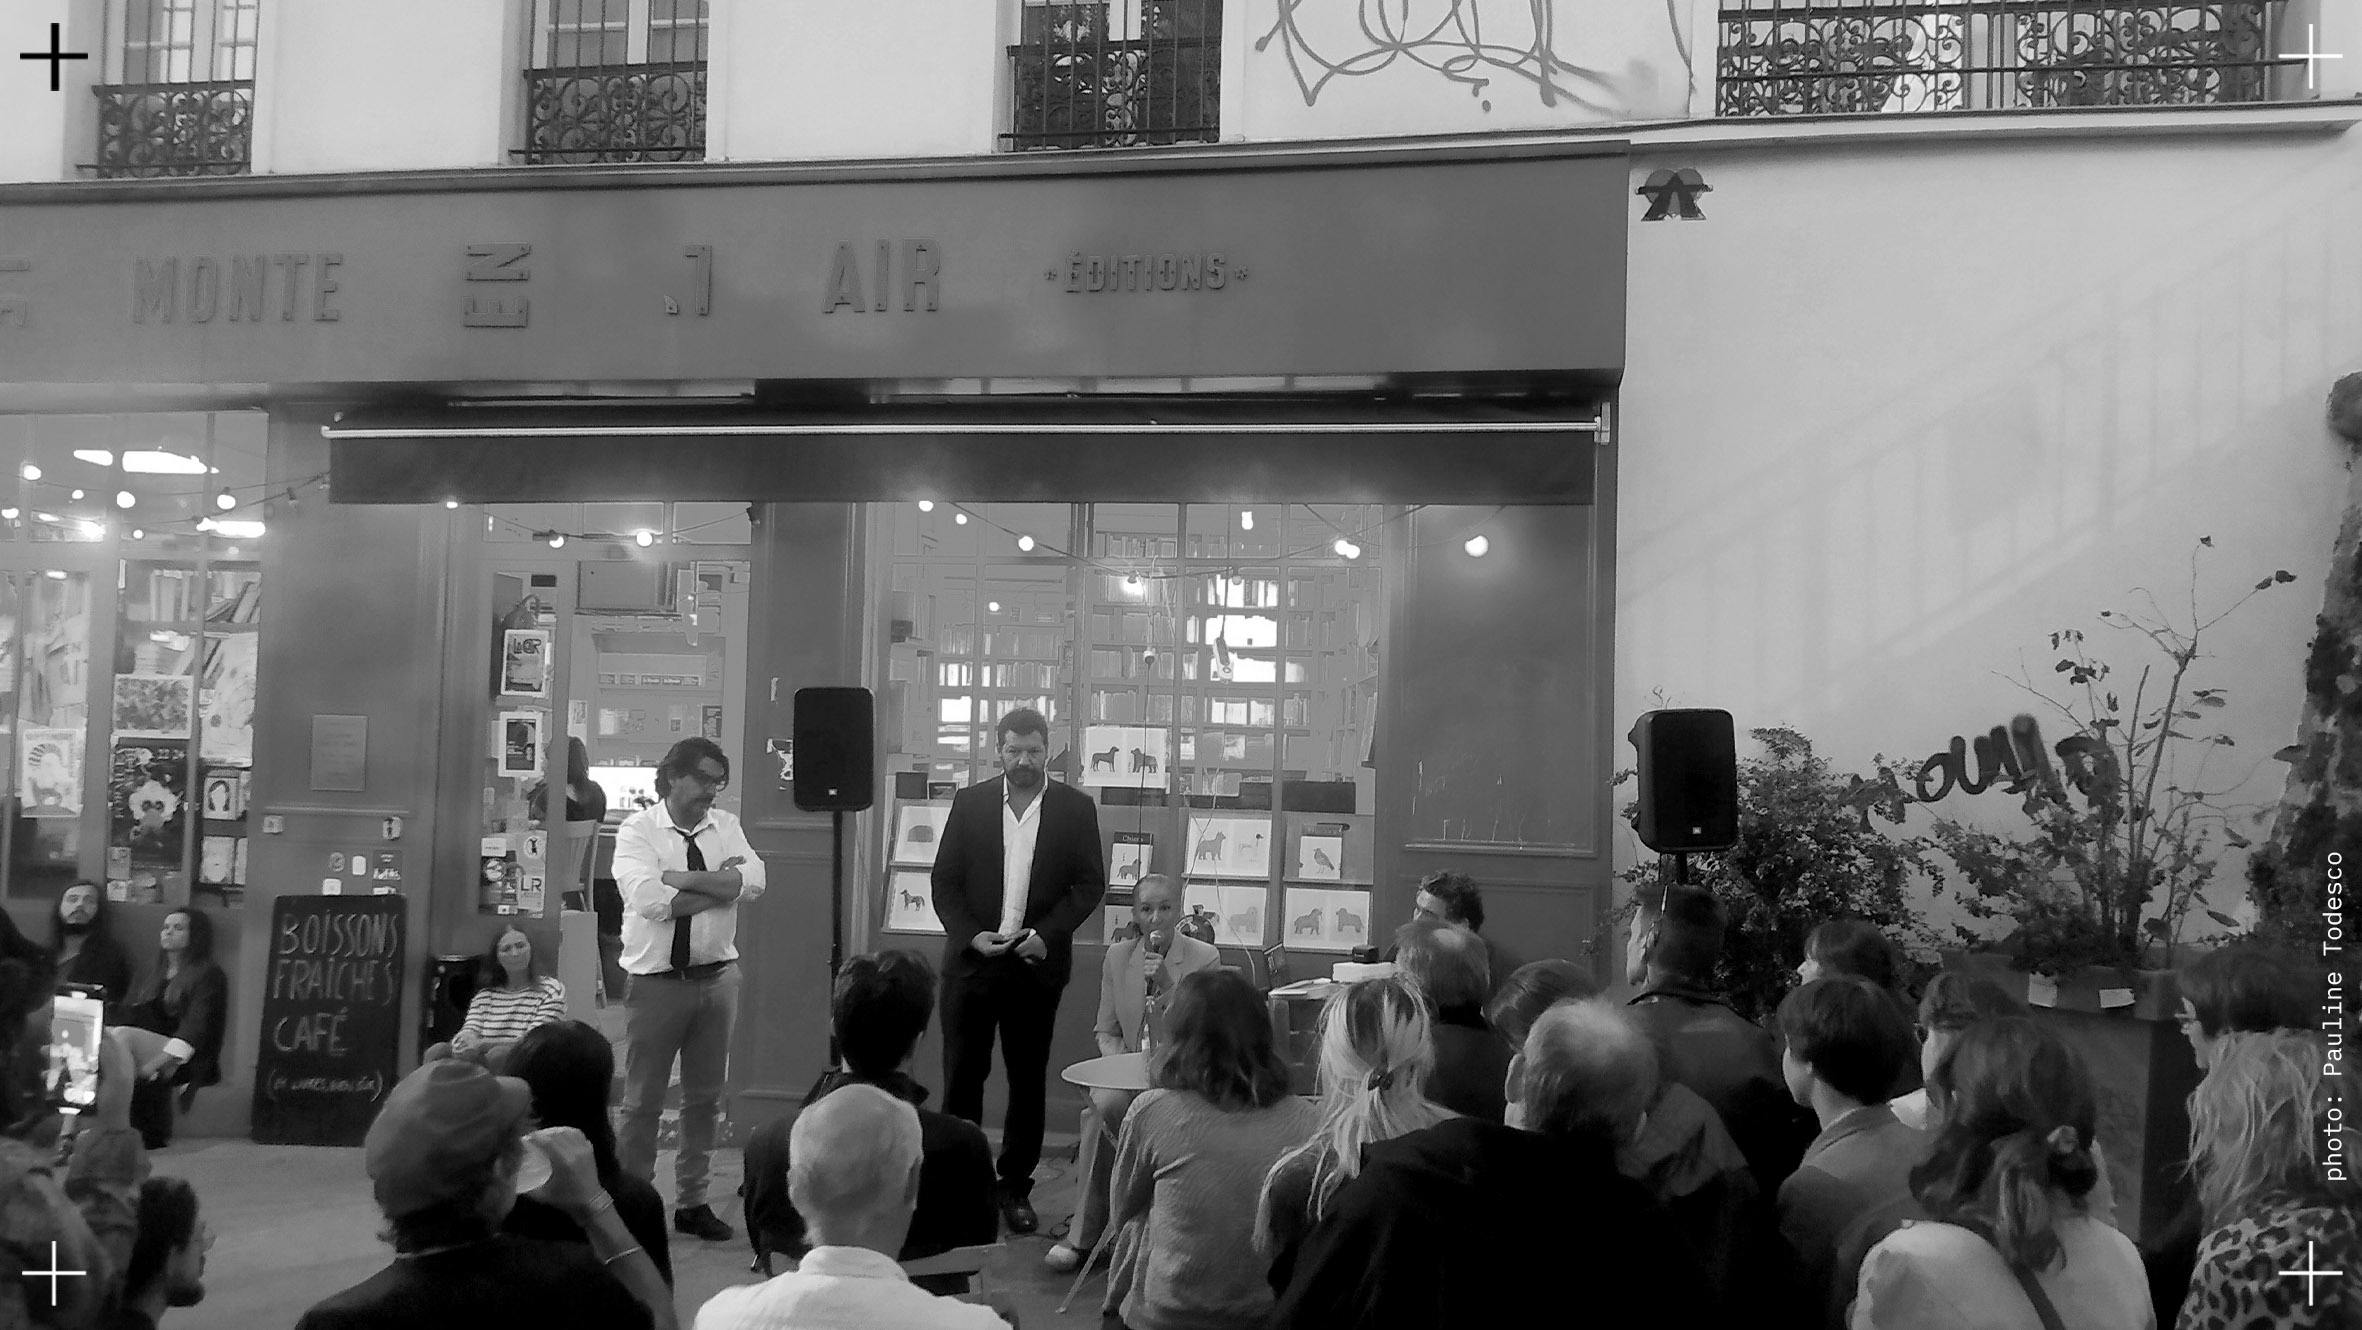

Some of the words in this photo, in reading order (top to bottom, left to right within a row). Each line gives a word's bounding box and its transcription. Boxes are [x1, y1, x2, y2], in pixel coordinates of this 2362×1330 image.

[132, 253, 343, 325] MONTE
[462, 241, 532, 329] EN
[820, 237, 941, 314] AIR
[278, 909, 399, 959] BOISSONS
[273, 1007, 350, 1057] CAFÉ
